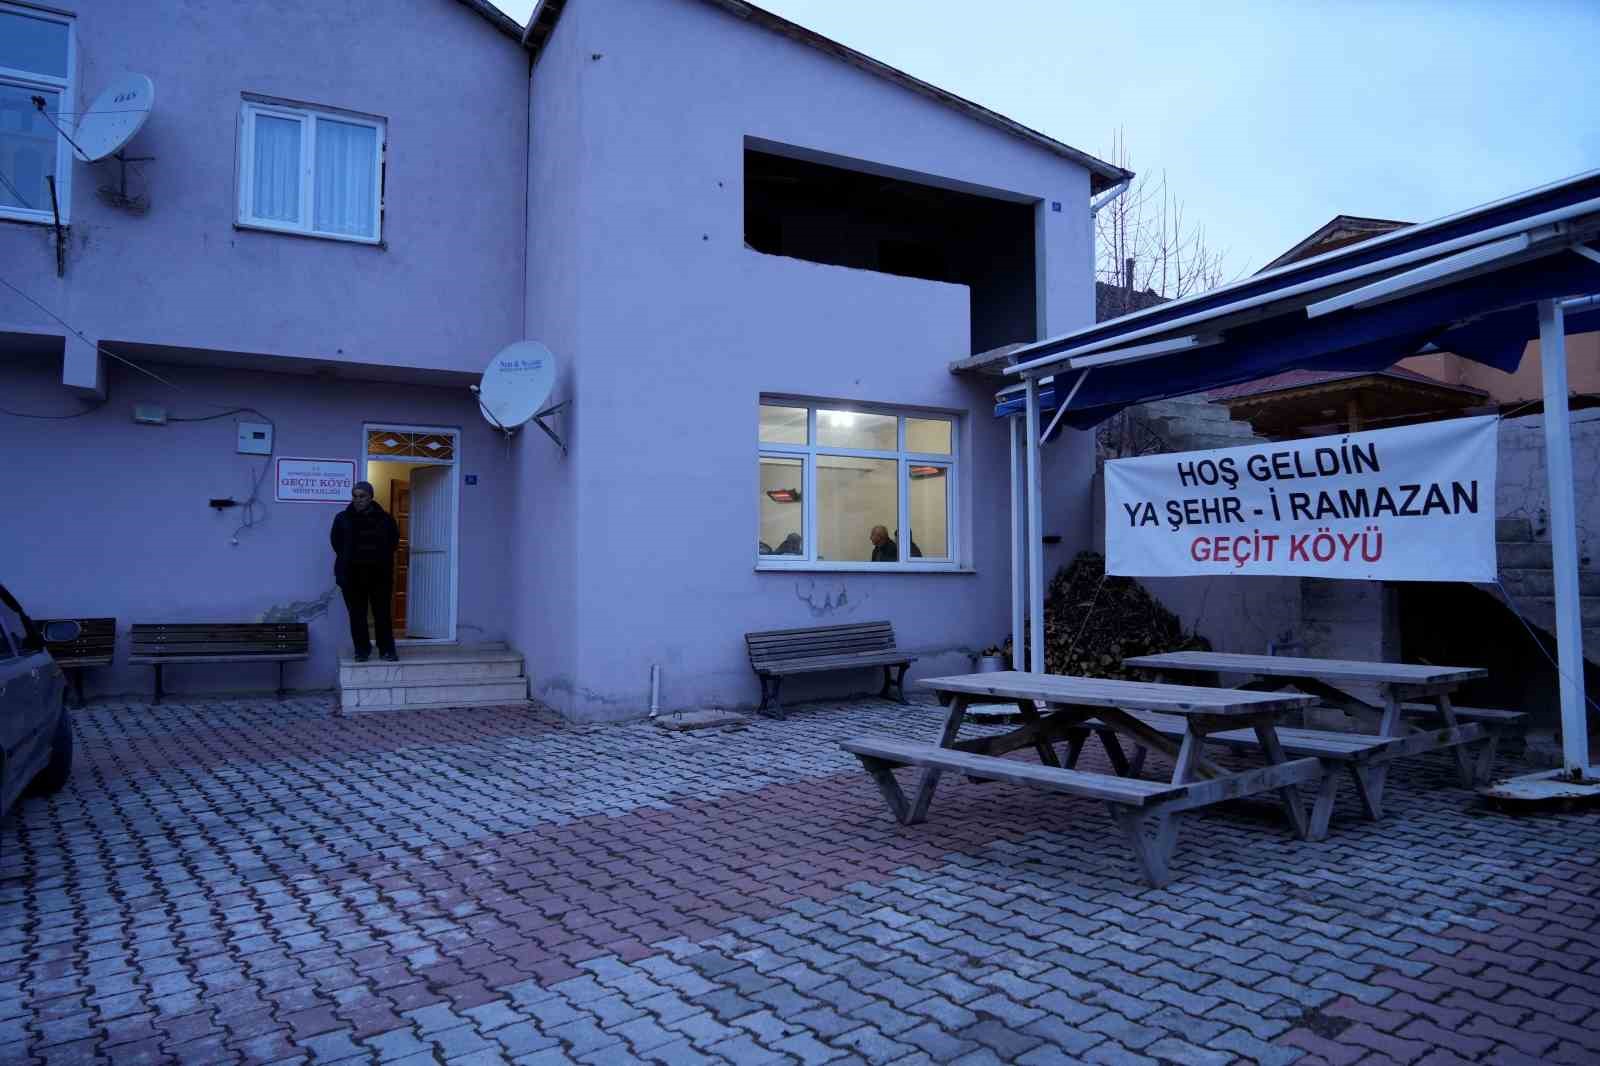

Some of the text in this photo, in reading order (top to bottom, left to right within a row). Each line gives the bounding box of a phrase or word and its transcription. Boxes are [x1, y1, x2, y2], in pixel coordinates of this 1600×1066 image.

[320, 477, 353, 488] KÖYÜ
[1176, 434, 1381, 492] HOŞ GELDİN
[1122, 501, 1162, 529] YA
[1166, 495, 1248, 533] ŞEHR
[1268, 486, 1283, 522] İ
[1288, 479, 1479, 522] RAMAZAN
[1190, 525, 1383, 567] GEÇİT KÖYÜ
